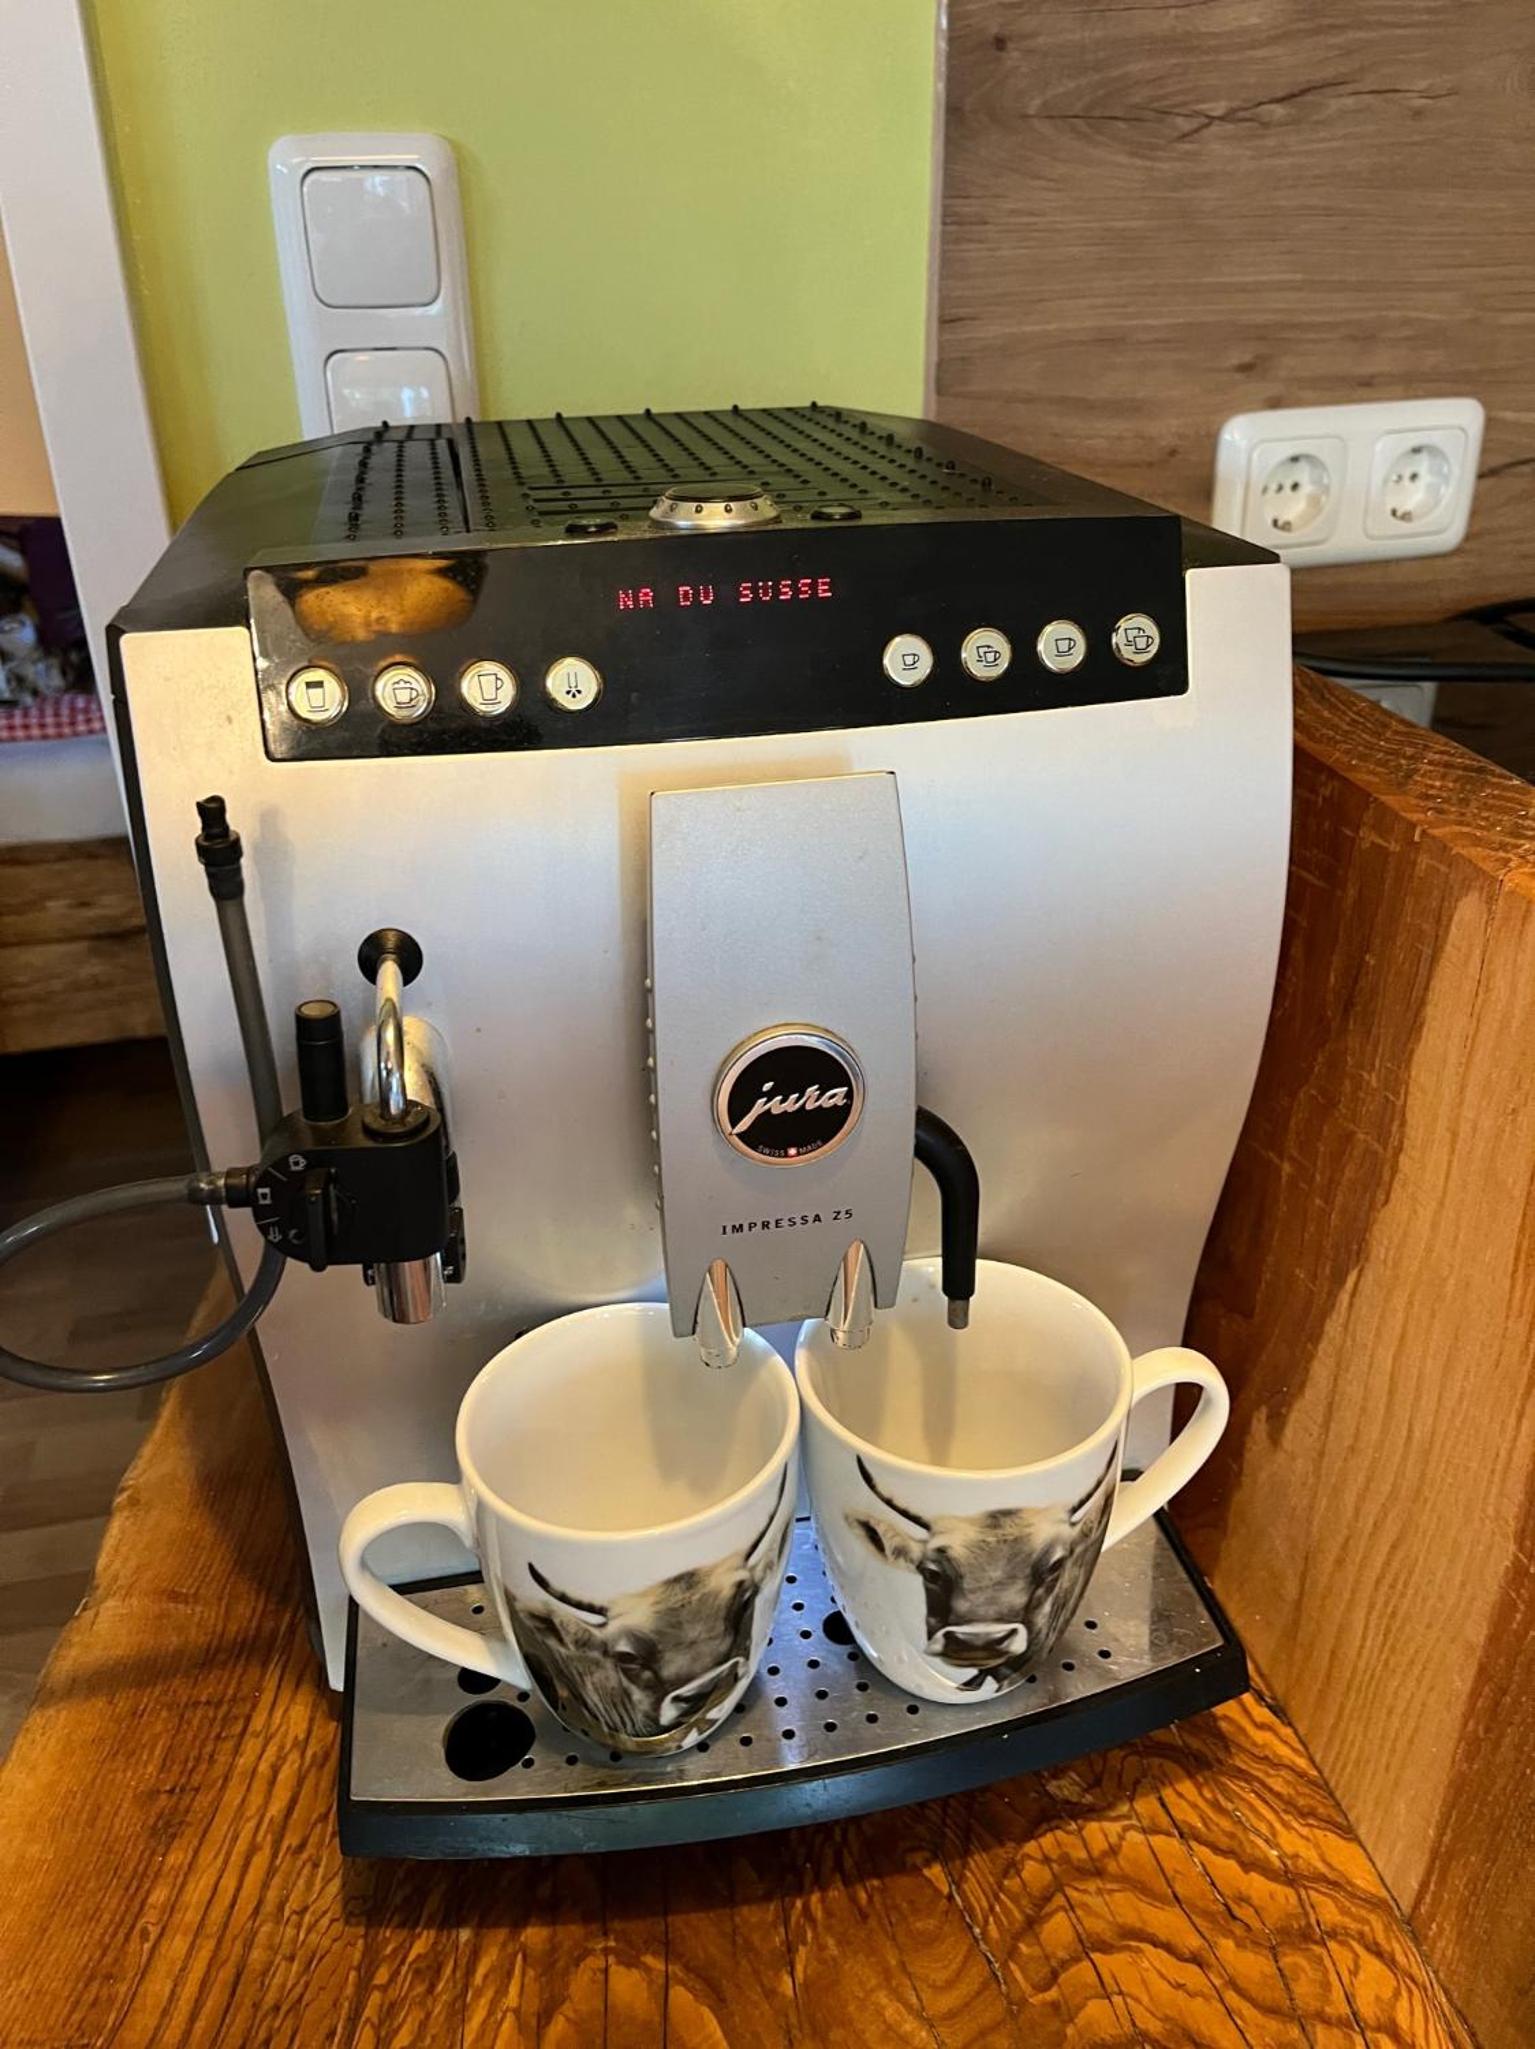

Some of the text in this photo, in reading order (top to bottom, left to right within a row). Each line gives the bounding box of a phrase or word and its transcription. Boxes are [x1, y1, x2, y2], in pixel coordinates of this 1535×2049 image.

[618, 588, 654, 610] NA
[678, 585, 714, 606] DU
[731, 1081, 849, 1135] jura
[757, 1144, 786, 1157] SWISS
[721, 1208, 853, 1236] IMPRESSA Z5
